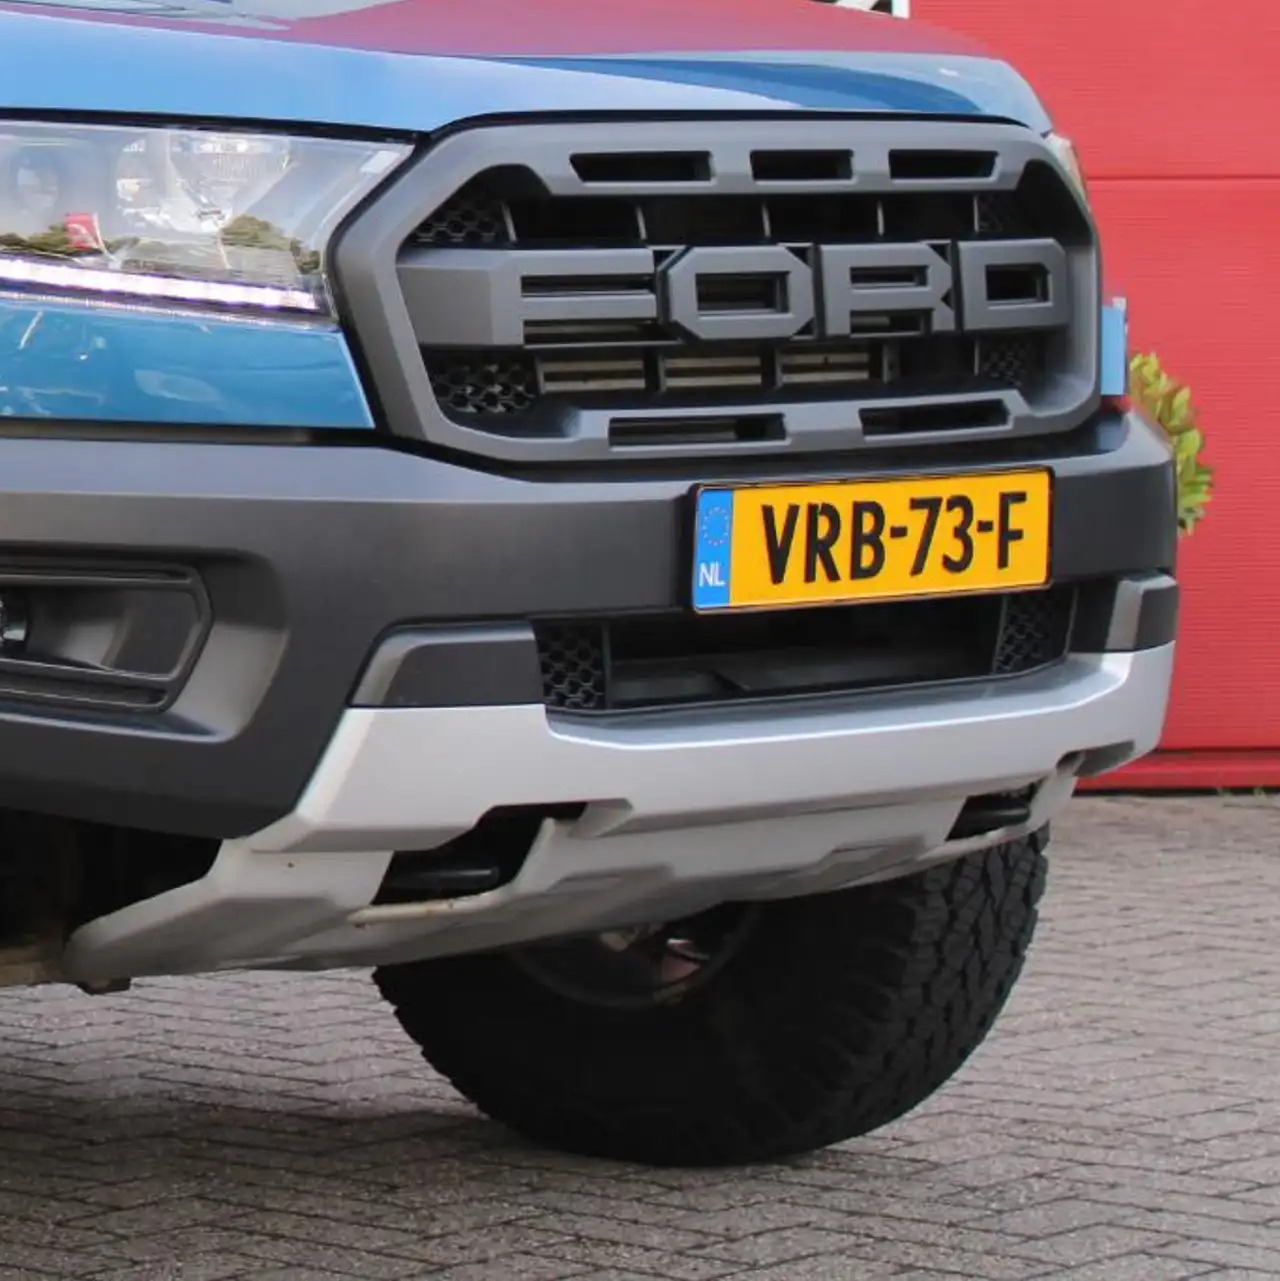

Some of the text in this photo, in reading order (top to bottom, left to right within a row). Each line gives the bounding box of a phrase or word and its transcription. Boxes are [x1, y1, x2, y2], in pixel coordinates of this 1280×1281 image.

[470, 237, 1068, 348] FORD
[698, 561, 726, 588] NL
[760, 491, 1028, 585] VRB-73-F
